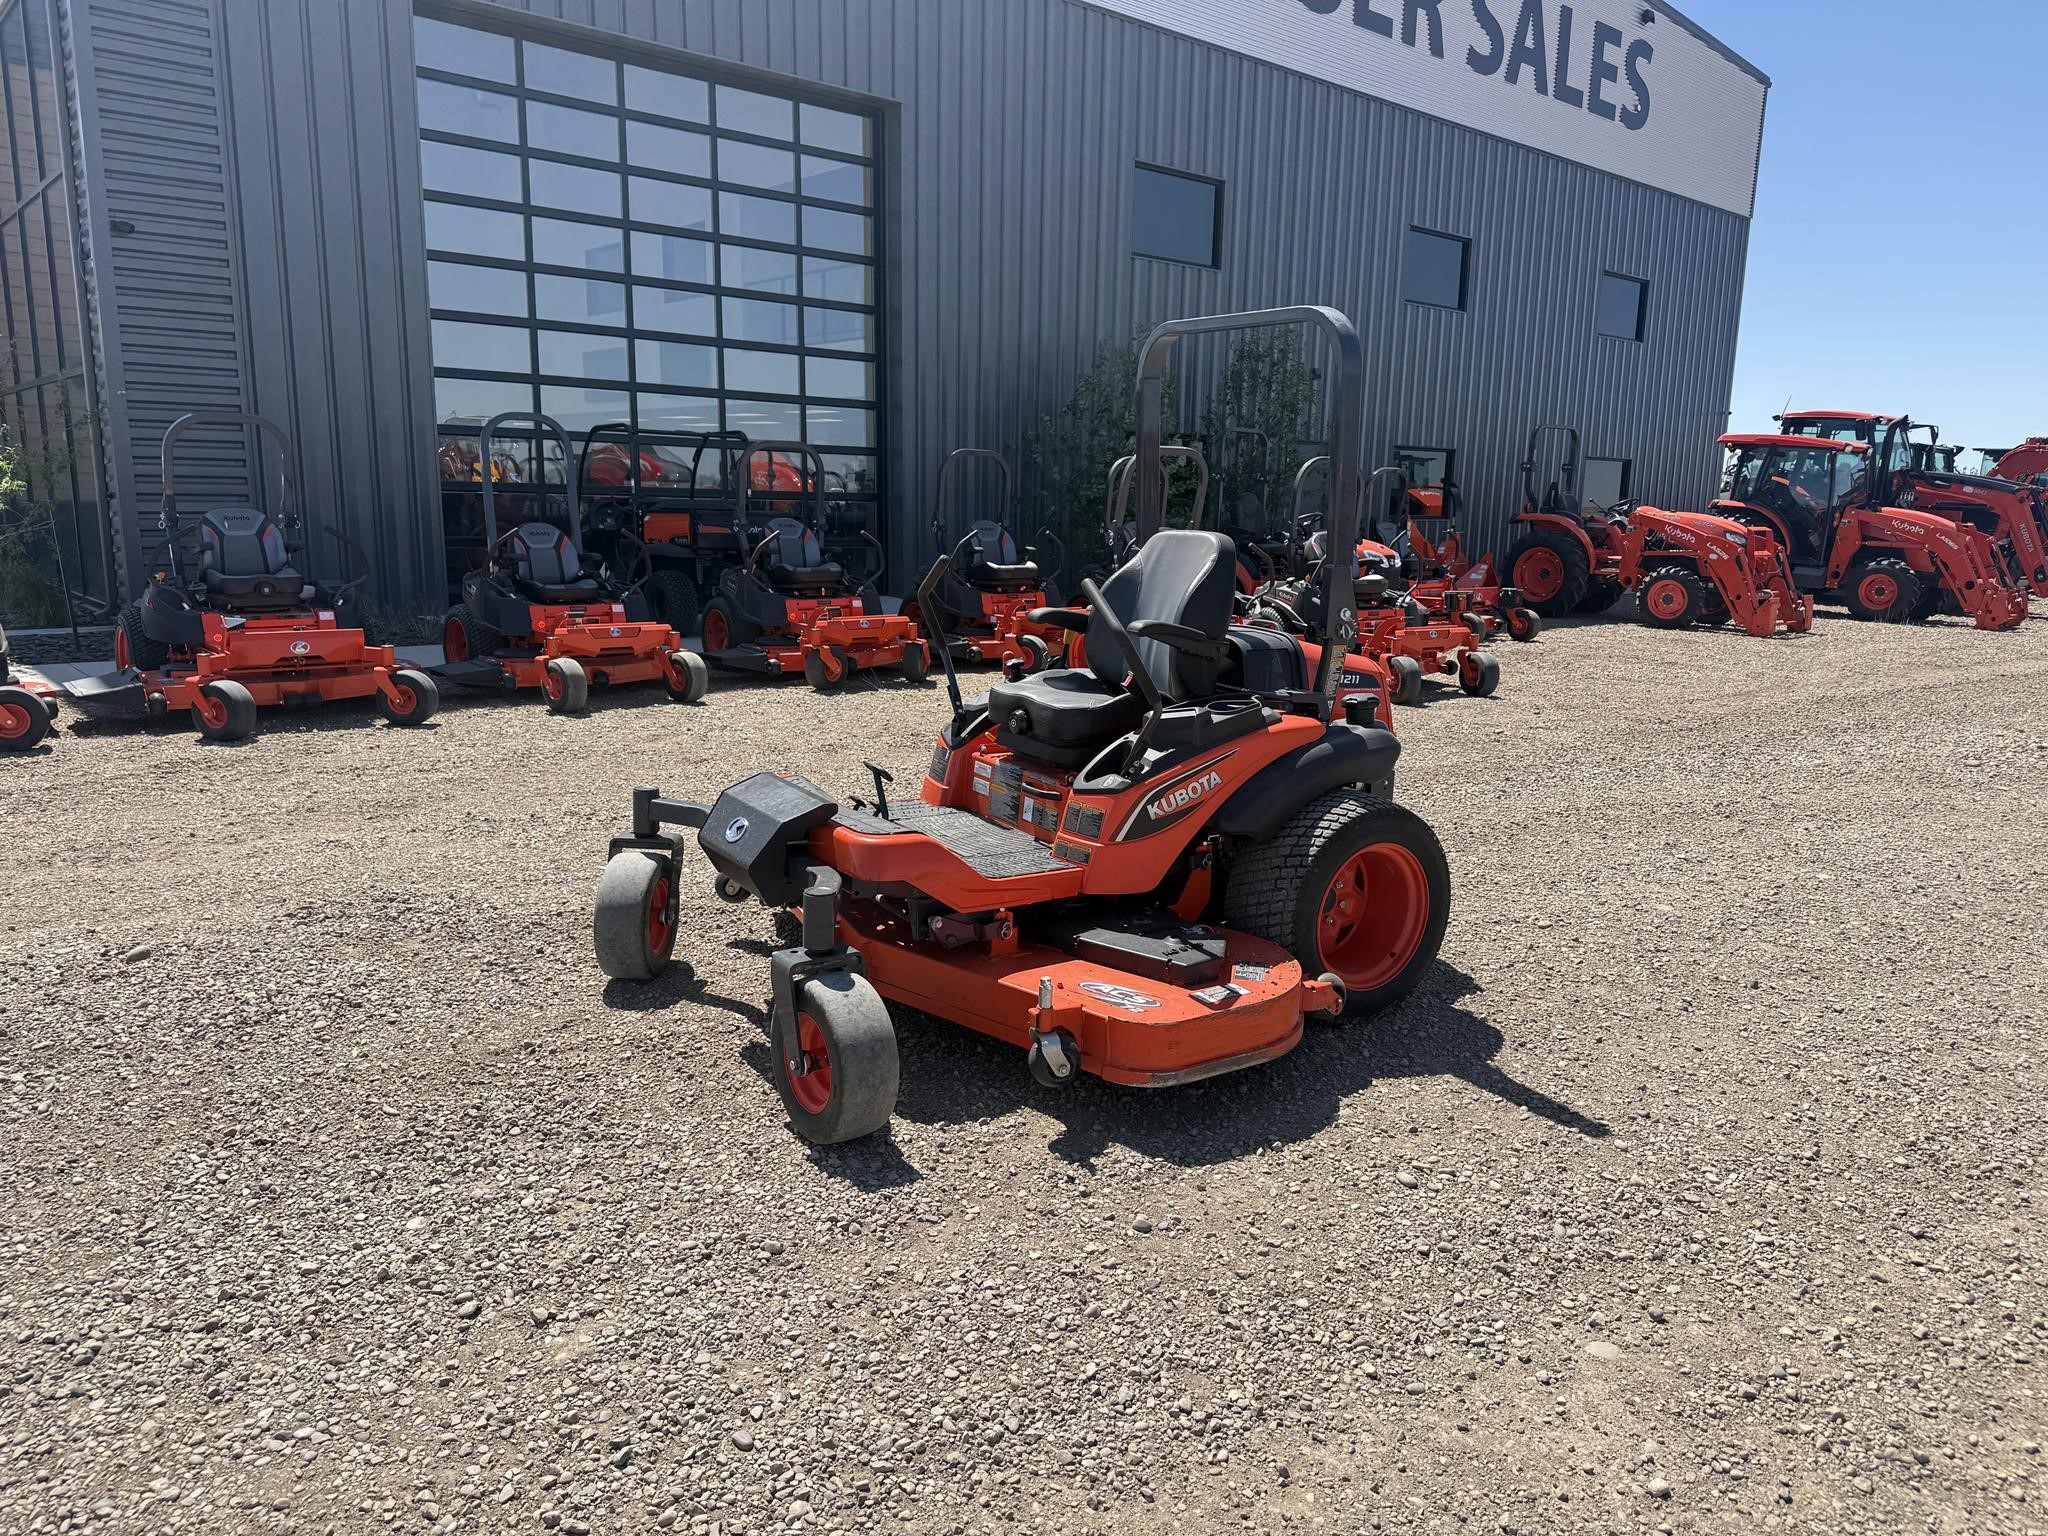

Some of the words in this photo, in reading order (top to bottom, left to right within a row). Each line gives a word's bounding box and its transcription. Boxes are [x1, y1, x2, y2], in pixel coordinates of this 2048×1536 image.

[1465, 0, 1653, 130] SALES
[1664, 523, 1697, 544] Kubota
[1891, 519, 1925, 535] Kubota
[2019, 523, 2035, 553] KUBOTA
[1146, 770, 1223, 821] KUBOTA
[1083, 983, 1156, 1004] ACS
